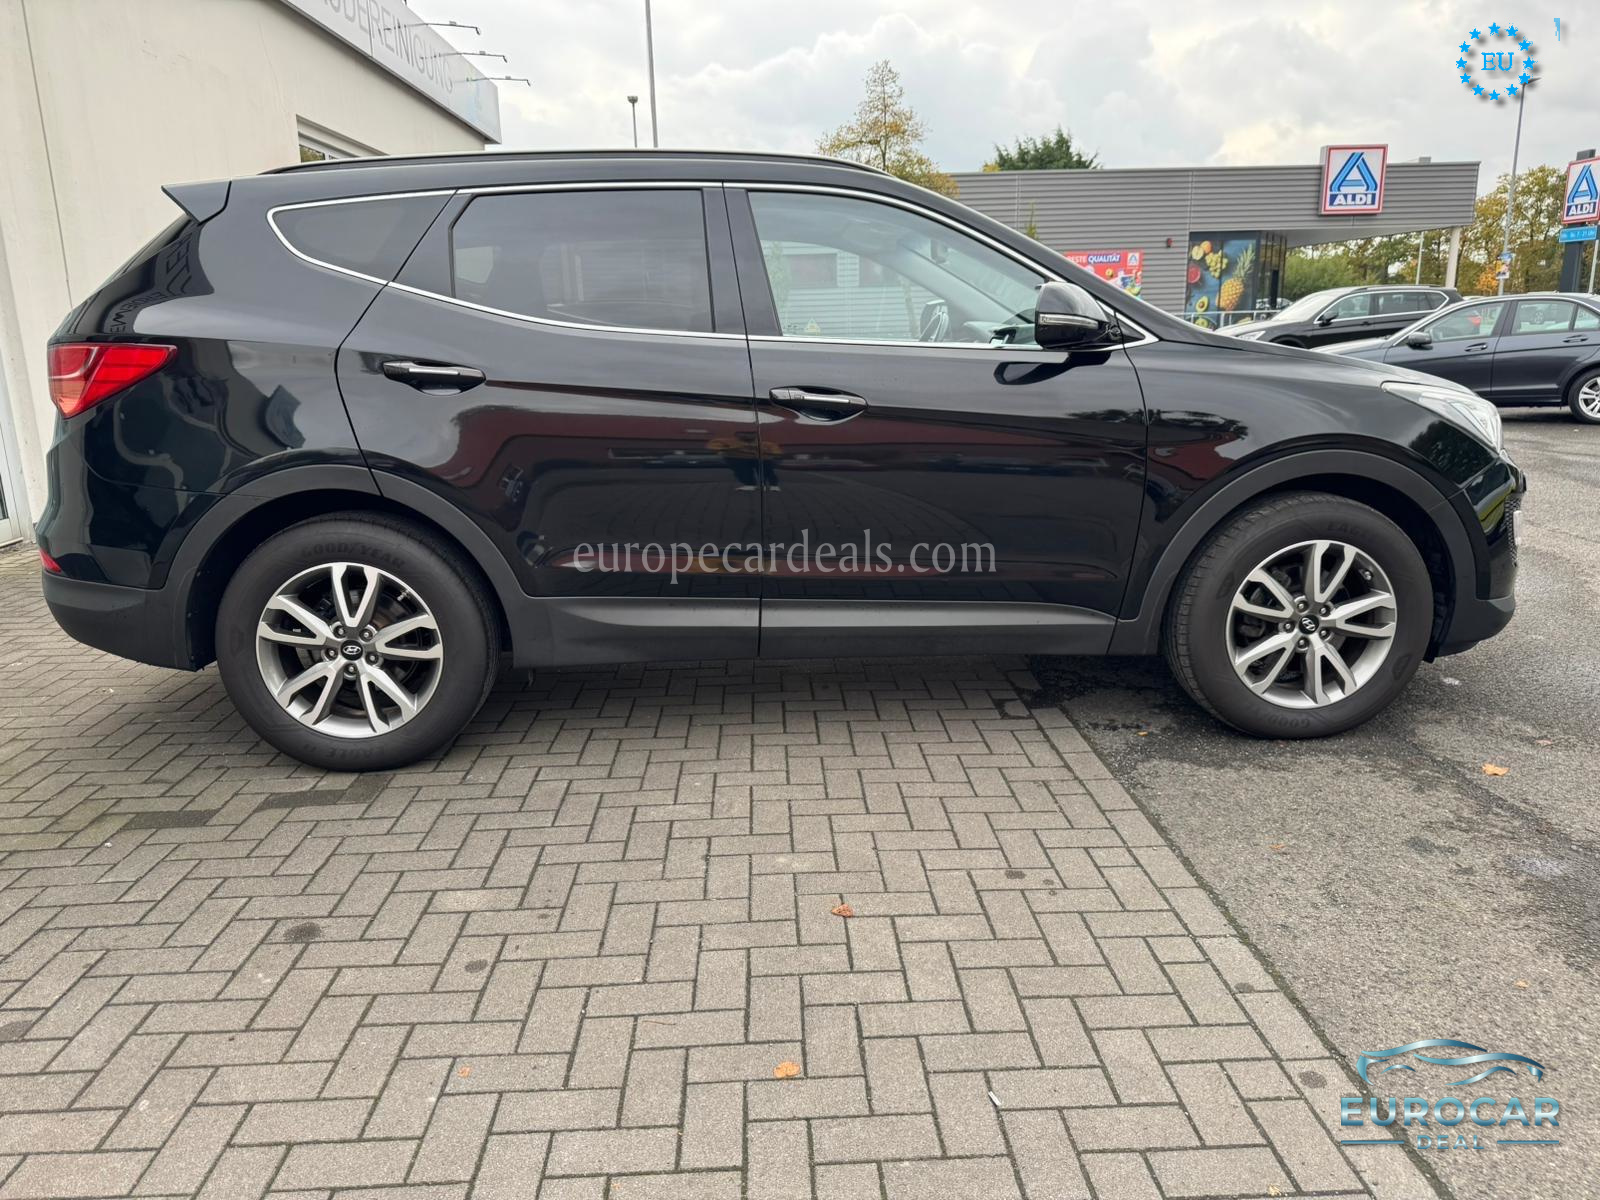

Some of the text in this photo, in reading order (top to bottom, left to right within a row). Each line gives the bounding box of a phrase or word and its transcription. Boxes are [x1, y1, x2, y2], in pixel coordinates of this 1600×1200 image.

[323, 0, 454, 95] DEREINIGUNG
[1333, 193, 1373, 206] ALDI
[1568, 203, 1594, 216] ALDI
